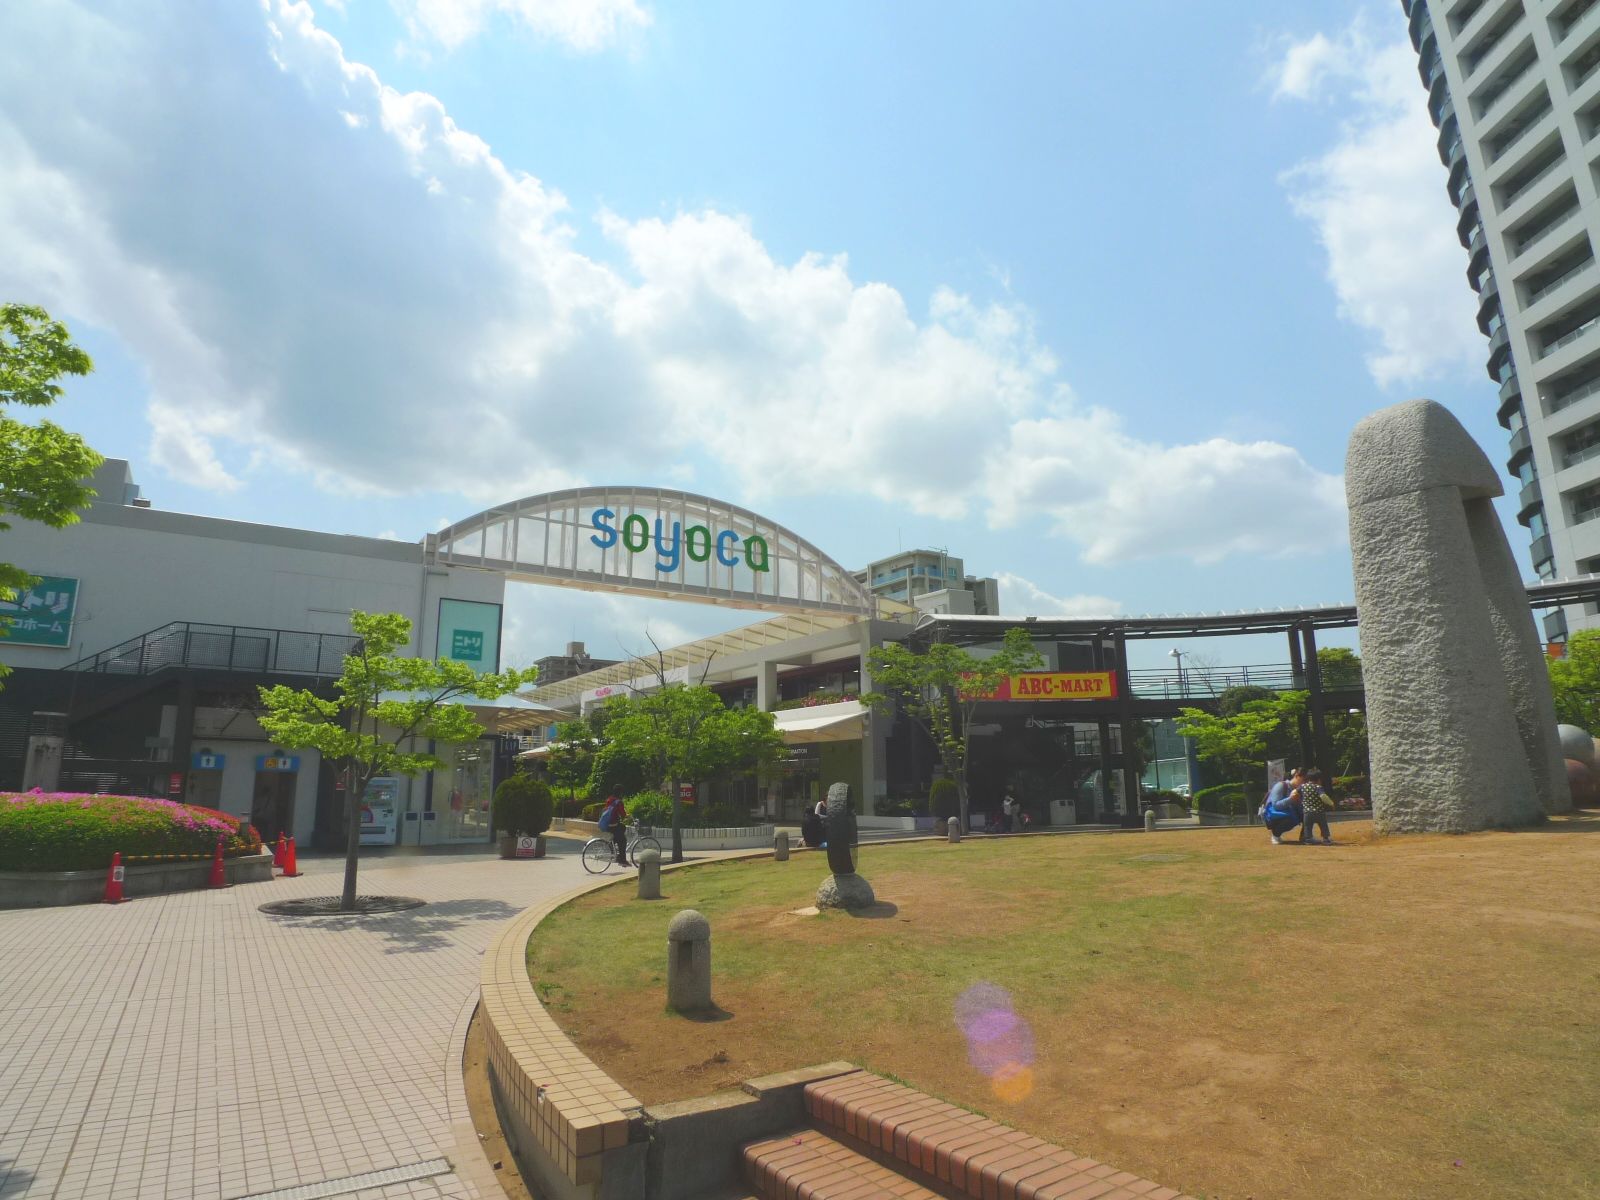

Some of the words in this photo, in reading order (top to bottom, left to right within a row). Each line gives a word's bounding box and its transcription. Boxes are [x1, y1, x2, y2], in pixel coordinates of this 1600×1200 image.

[590, 508, 770, 573] soyoca
[454, 635, 481, 647] ニトリ
[1017, 677, 1104, 695] ABC-MART
